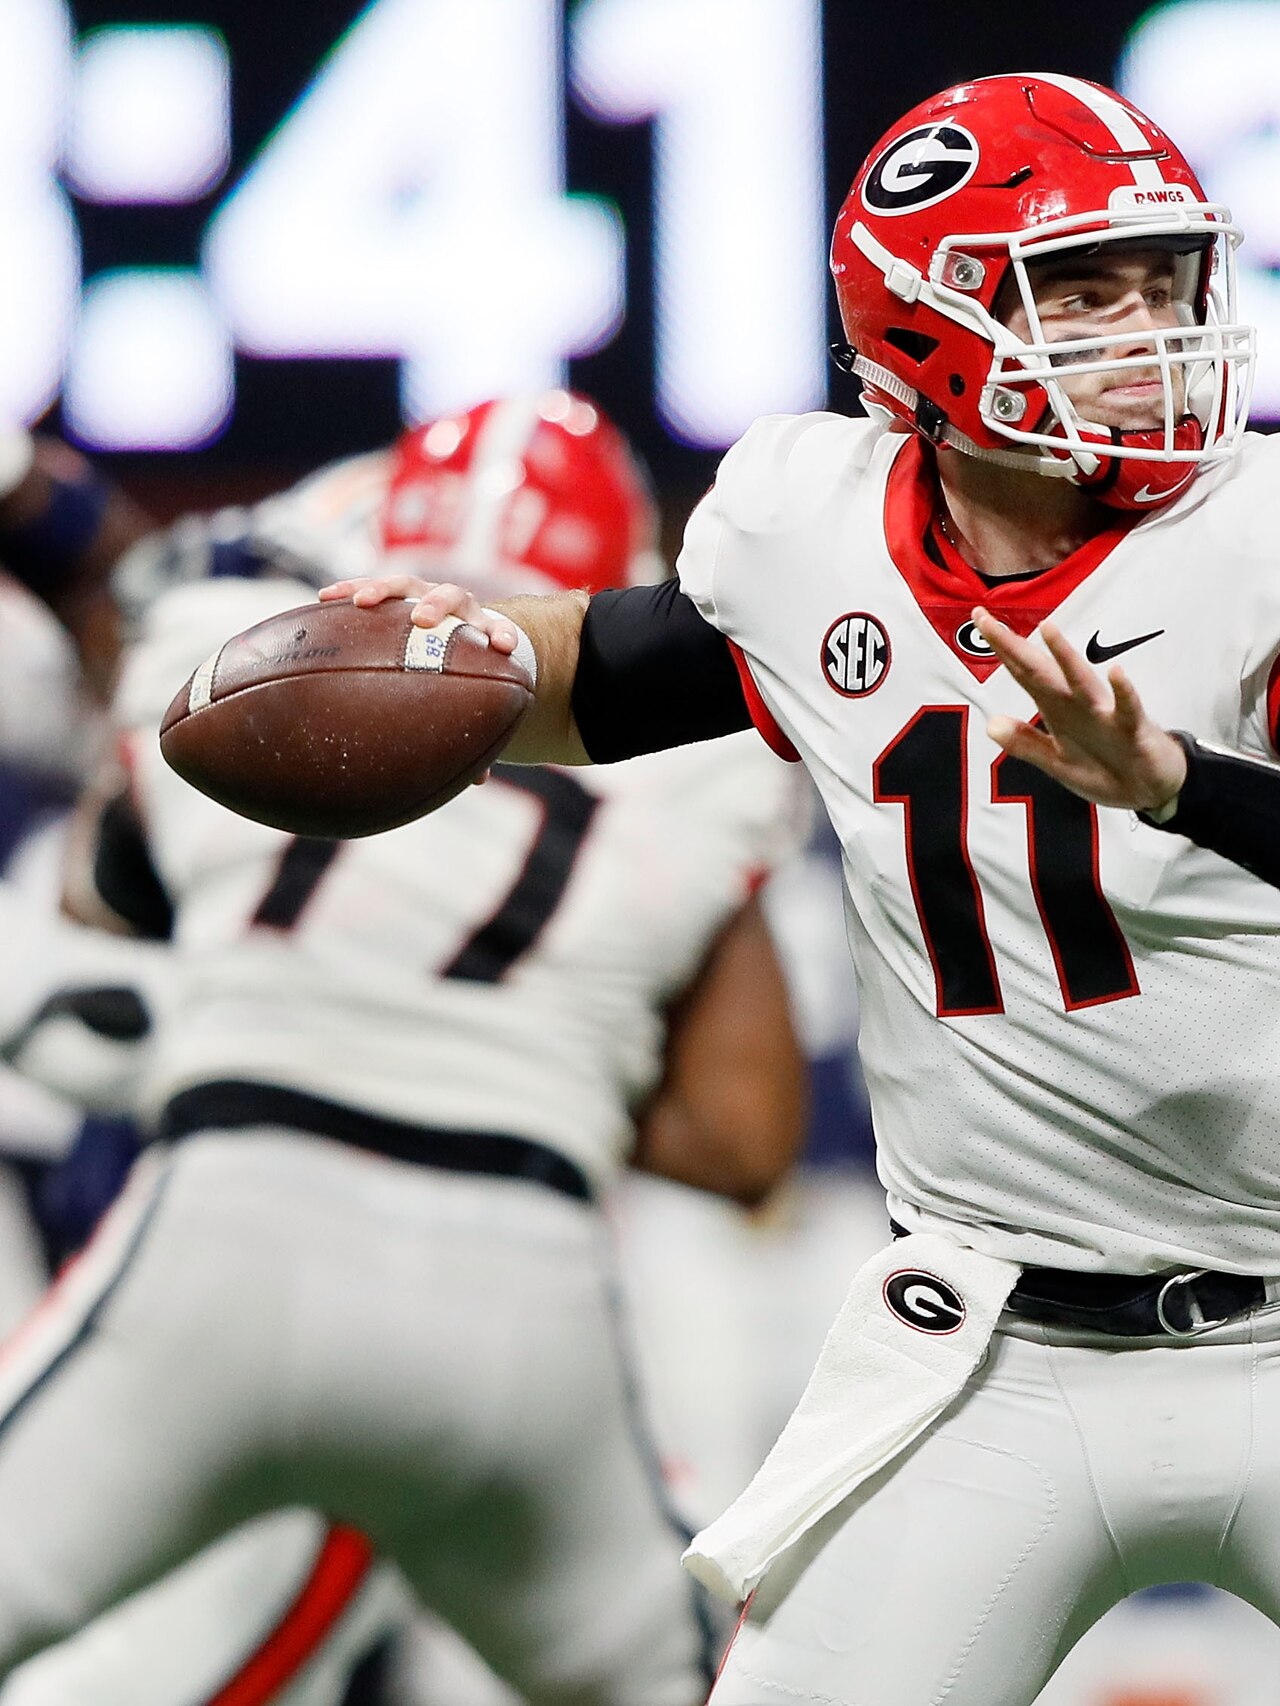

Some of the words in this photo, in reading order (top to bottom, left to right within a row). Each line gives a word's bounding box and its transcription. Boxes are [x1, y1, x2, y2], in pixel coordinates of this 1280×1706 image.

[864, 124, 976, 211] G
[1134, 190, 1185, 205] DAWGS
[826, 616, 886, 692] SEC
[872, 704, 1142, 1019] 11
[885, 1272, 964, 1332] G
